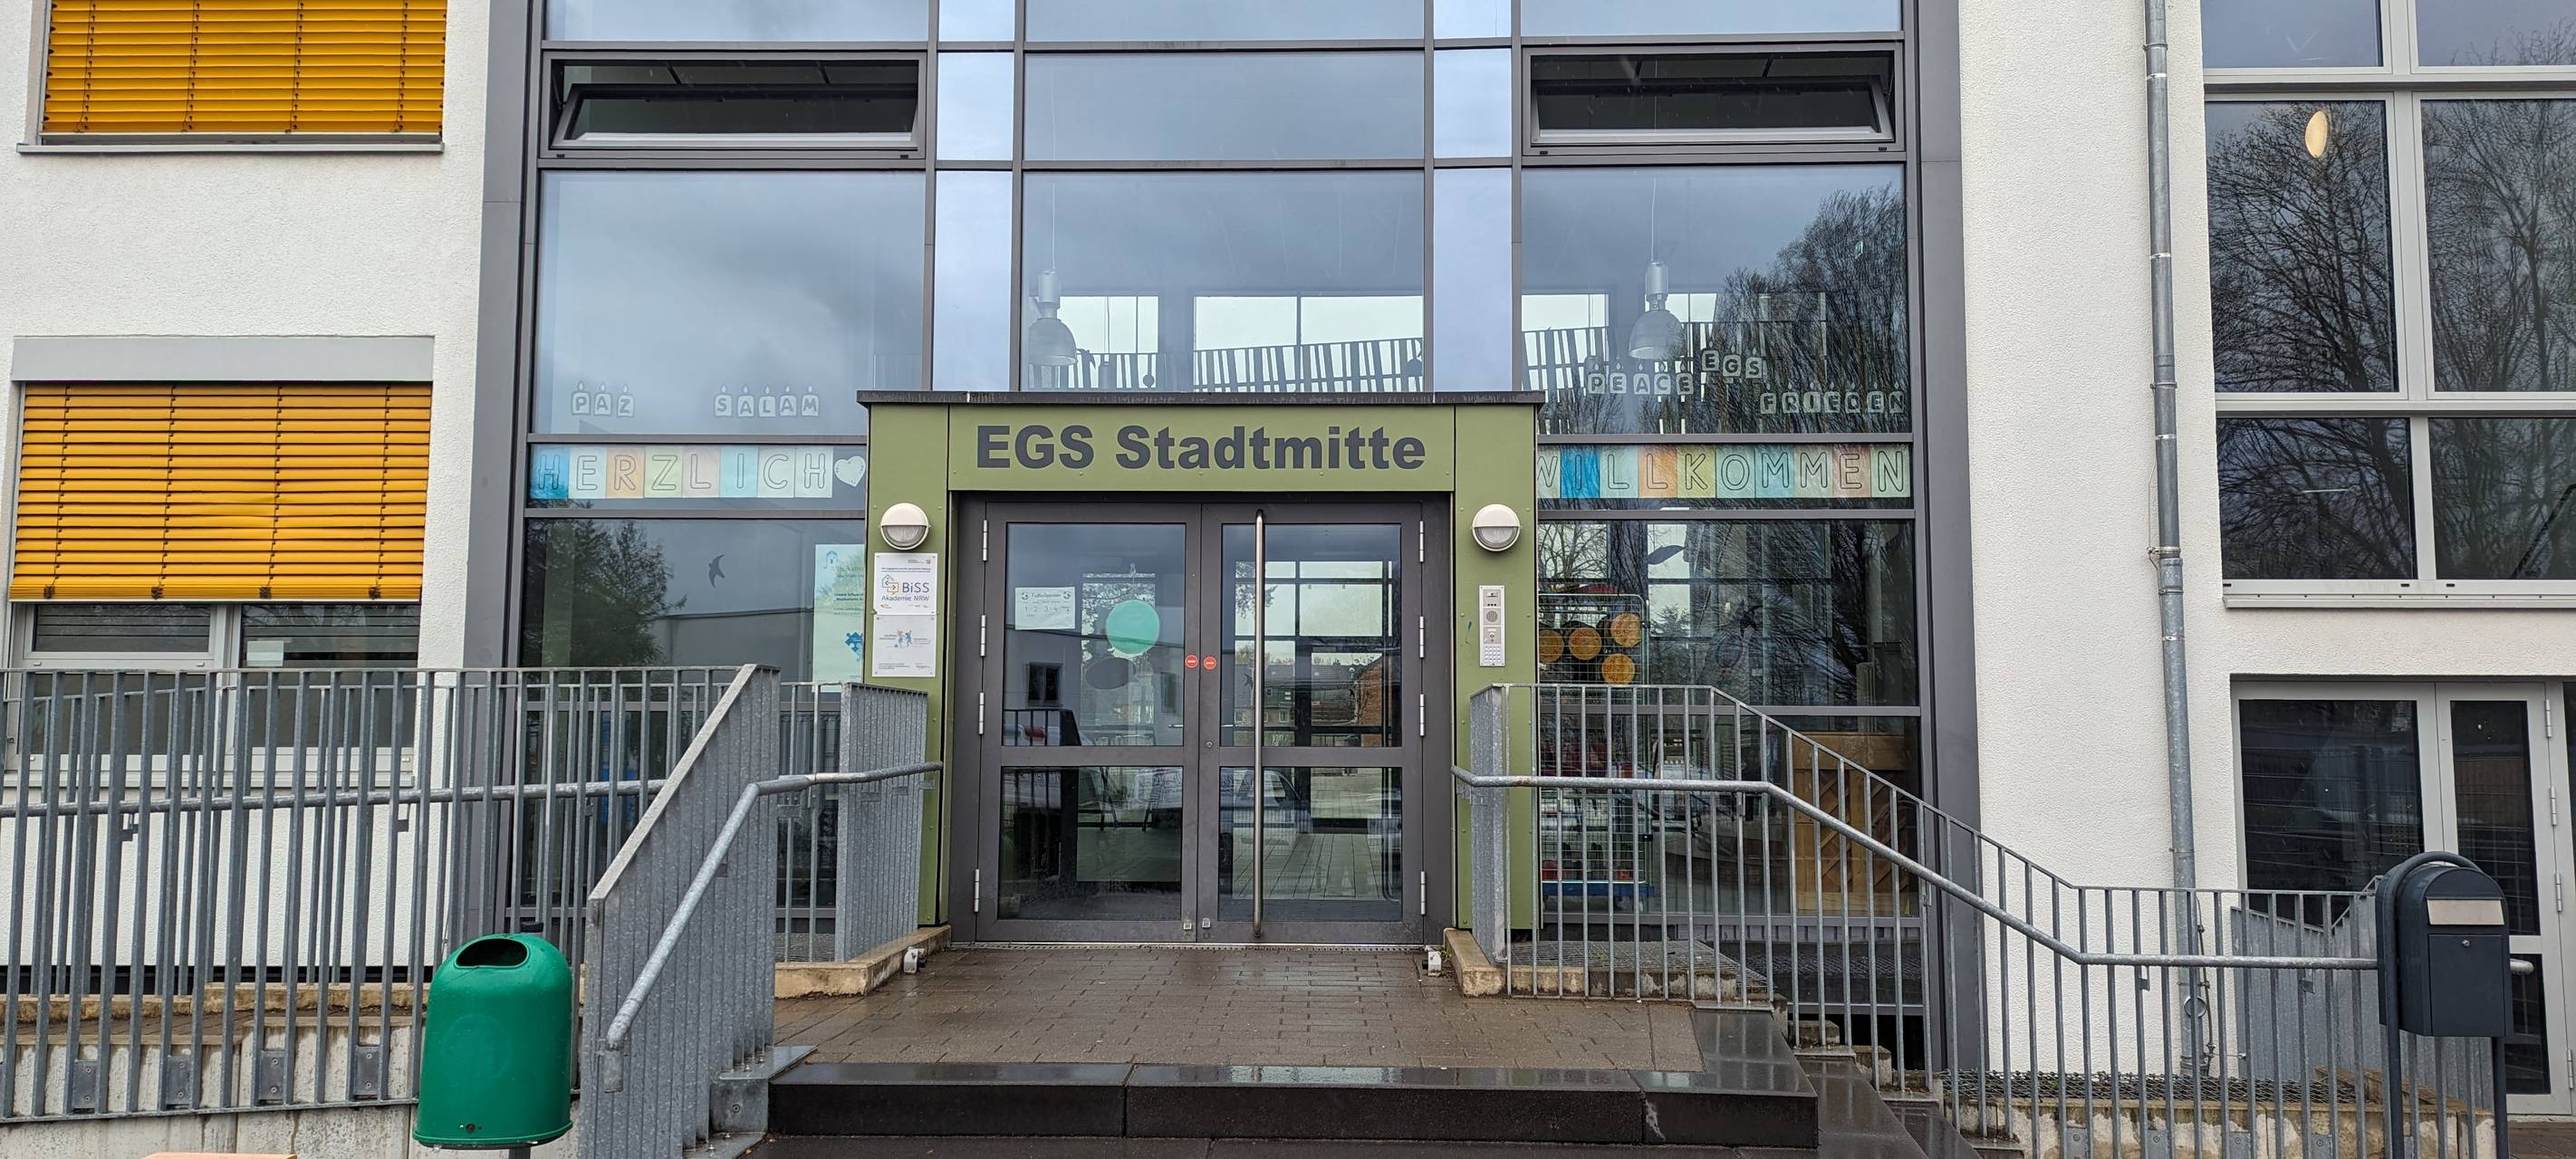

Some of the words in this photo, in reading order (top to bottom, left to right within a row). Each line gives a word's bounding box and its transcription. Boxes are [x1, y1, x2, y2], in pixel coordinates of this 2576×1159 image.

[1706, 352, 1760, 375] EGS
[1591, 373, 1691, 392] PEACE
[575, 396, 630, 415] PAZ
[716, 398, 818, 415] SALAM
[1763, 393, 1903, 412] FRIEDEN
[976, 425, 1094, 470] EGS
[1116, 425, 1426, 470] Stadtmitte
[537, 453, 826, 492] HERZLICH
[1537, 449, 1904, 492] WILLKOMMEN
[902, 582, 929, 593] BiSS
